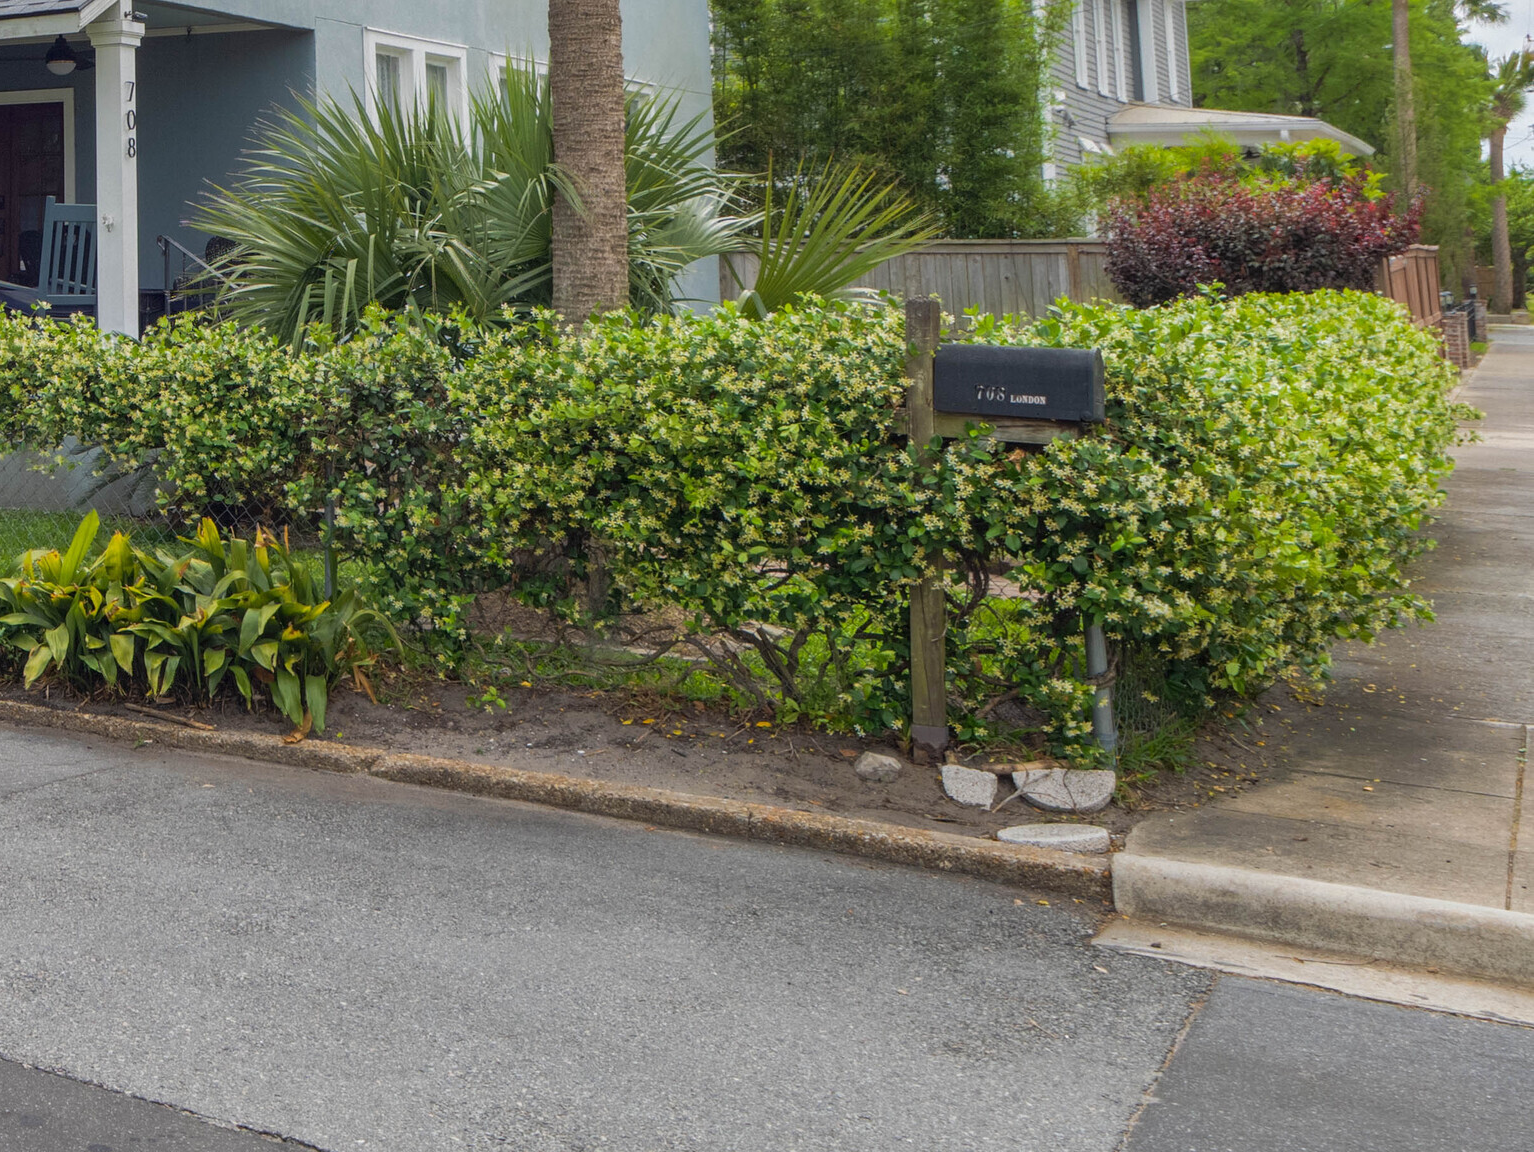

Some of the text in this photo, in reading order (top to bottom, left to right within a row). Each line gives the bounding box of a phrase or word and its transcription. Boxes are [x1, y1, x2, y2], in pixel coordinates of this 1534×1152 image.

[124, 80, 136, 158] 708
[975, 385, 1047, 405] 708 LONDON
